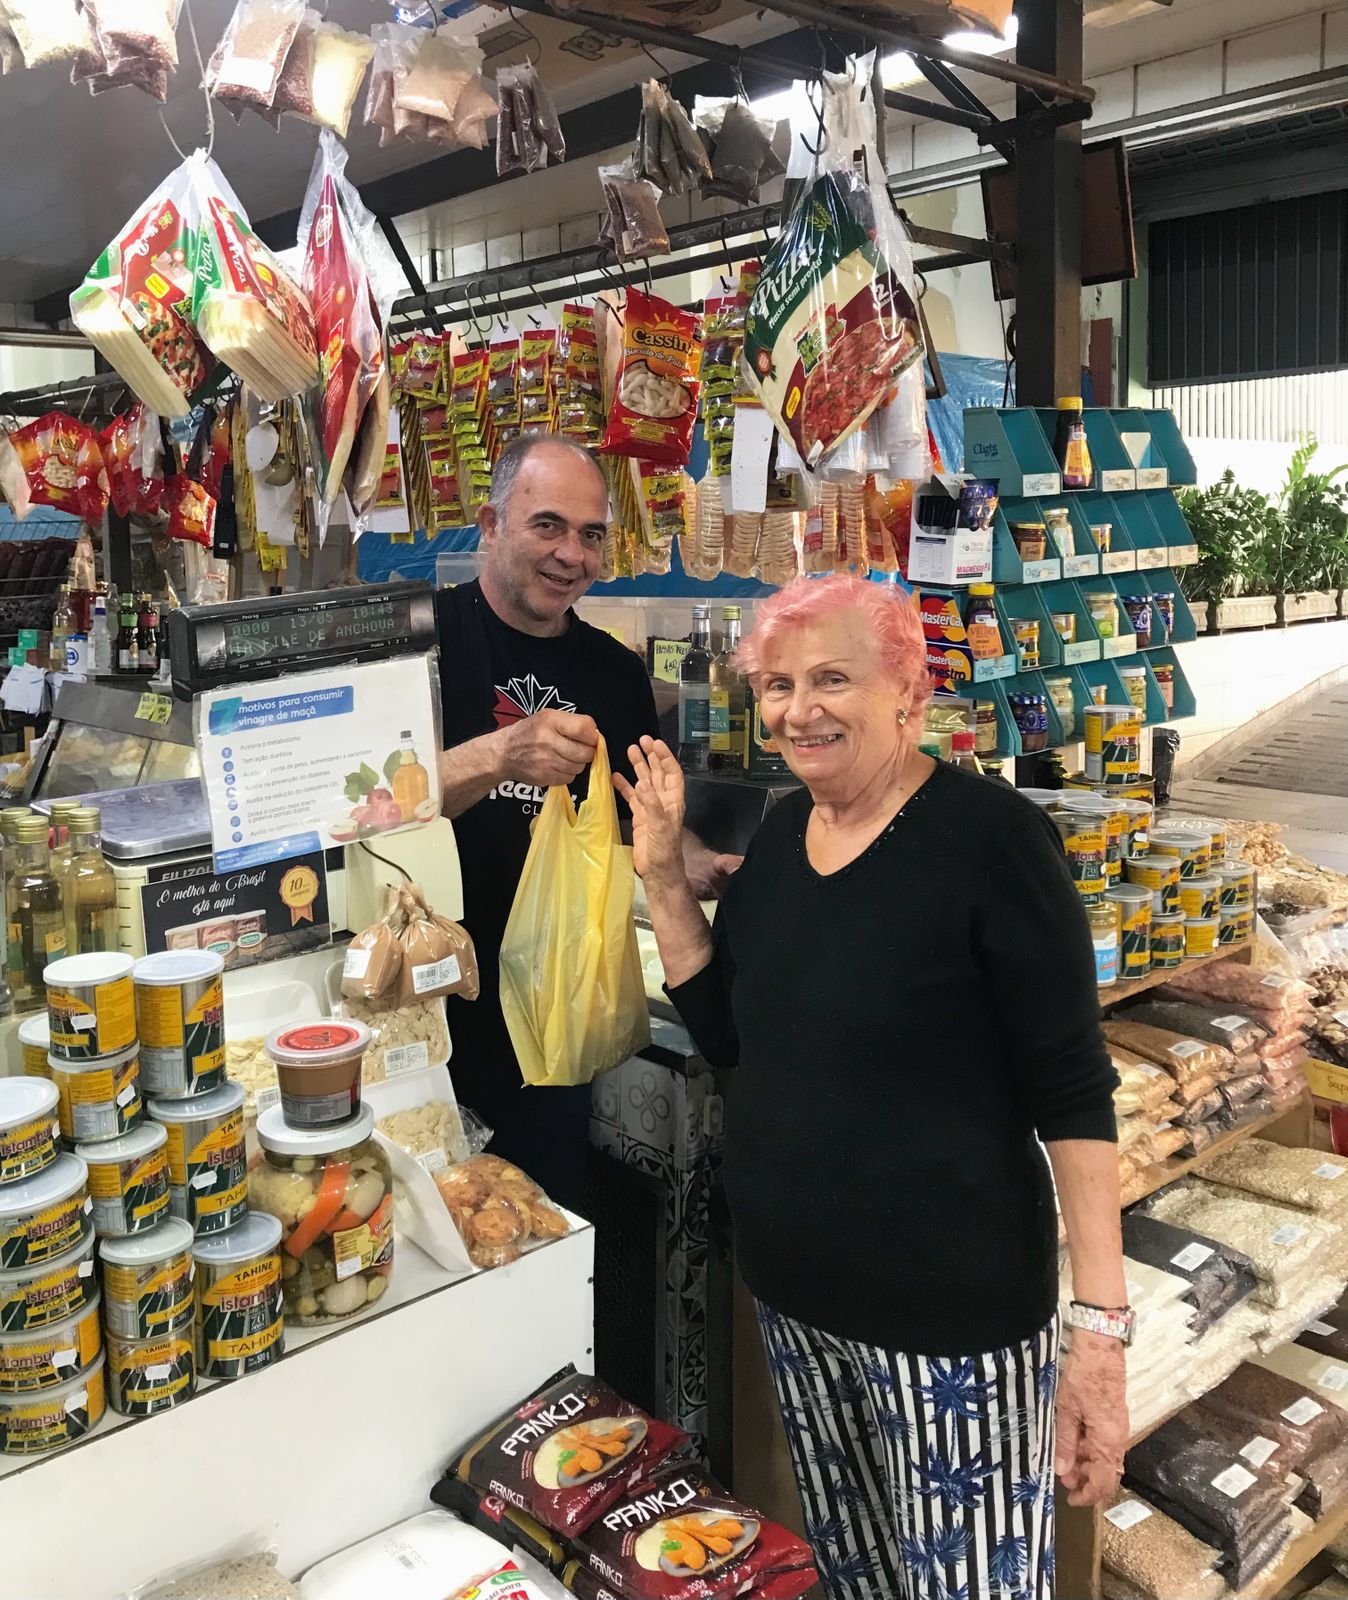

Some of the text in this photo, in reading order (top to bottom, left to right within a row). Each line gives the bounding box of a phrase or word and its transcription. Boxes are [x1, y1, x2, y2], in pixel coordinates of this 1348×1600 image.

[197, 240, 212, 281] Pizza
[768, 304, 785, 330] Massa
[784, 282, 801, 305] semi
[800, 257, 822, 288] pronta
[290, 614, 334, 629] 13/05
[352, 604, 394, 619] 10:43
[308, 630, 326, 642] DE
[336, 620, 395, 638] ANCHOVA
[238, 689, 344, 714] motivos para consumir
[238, 706, 316, 727] vinagre de maçã
[242, 757, 253, 765] Tem
[157, 870, 266, 907] O melhor do Brasil
[289, 877, 303, 893] 10
[192, 894, 236, 916] está aqui
[27, 1204, 80, 1239] istambul
[234, 1261, 273, 1282] TAHINE
[26, 1275, 79, 1304] istambu
[227, 1326, 280, 1354] TAHINE
[6, 1408, 65, 1430] istambul
[500, 1392, 586, 1457] PANKO
[489, 1480, 524, 1509] PANKO
[586, 1481, 606, 1498] 200g
[602, 1478, 697, 1532] PANKO
[589, 1553, 624, 1587] PANKO
